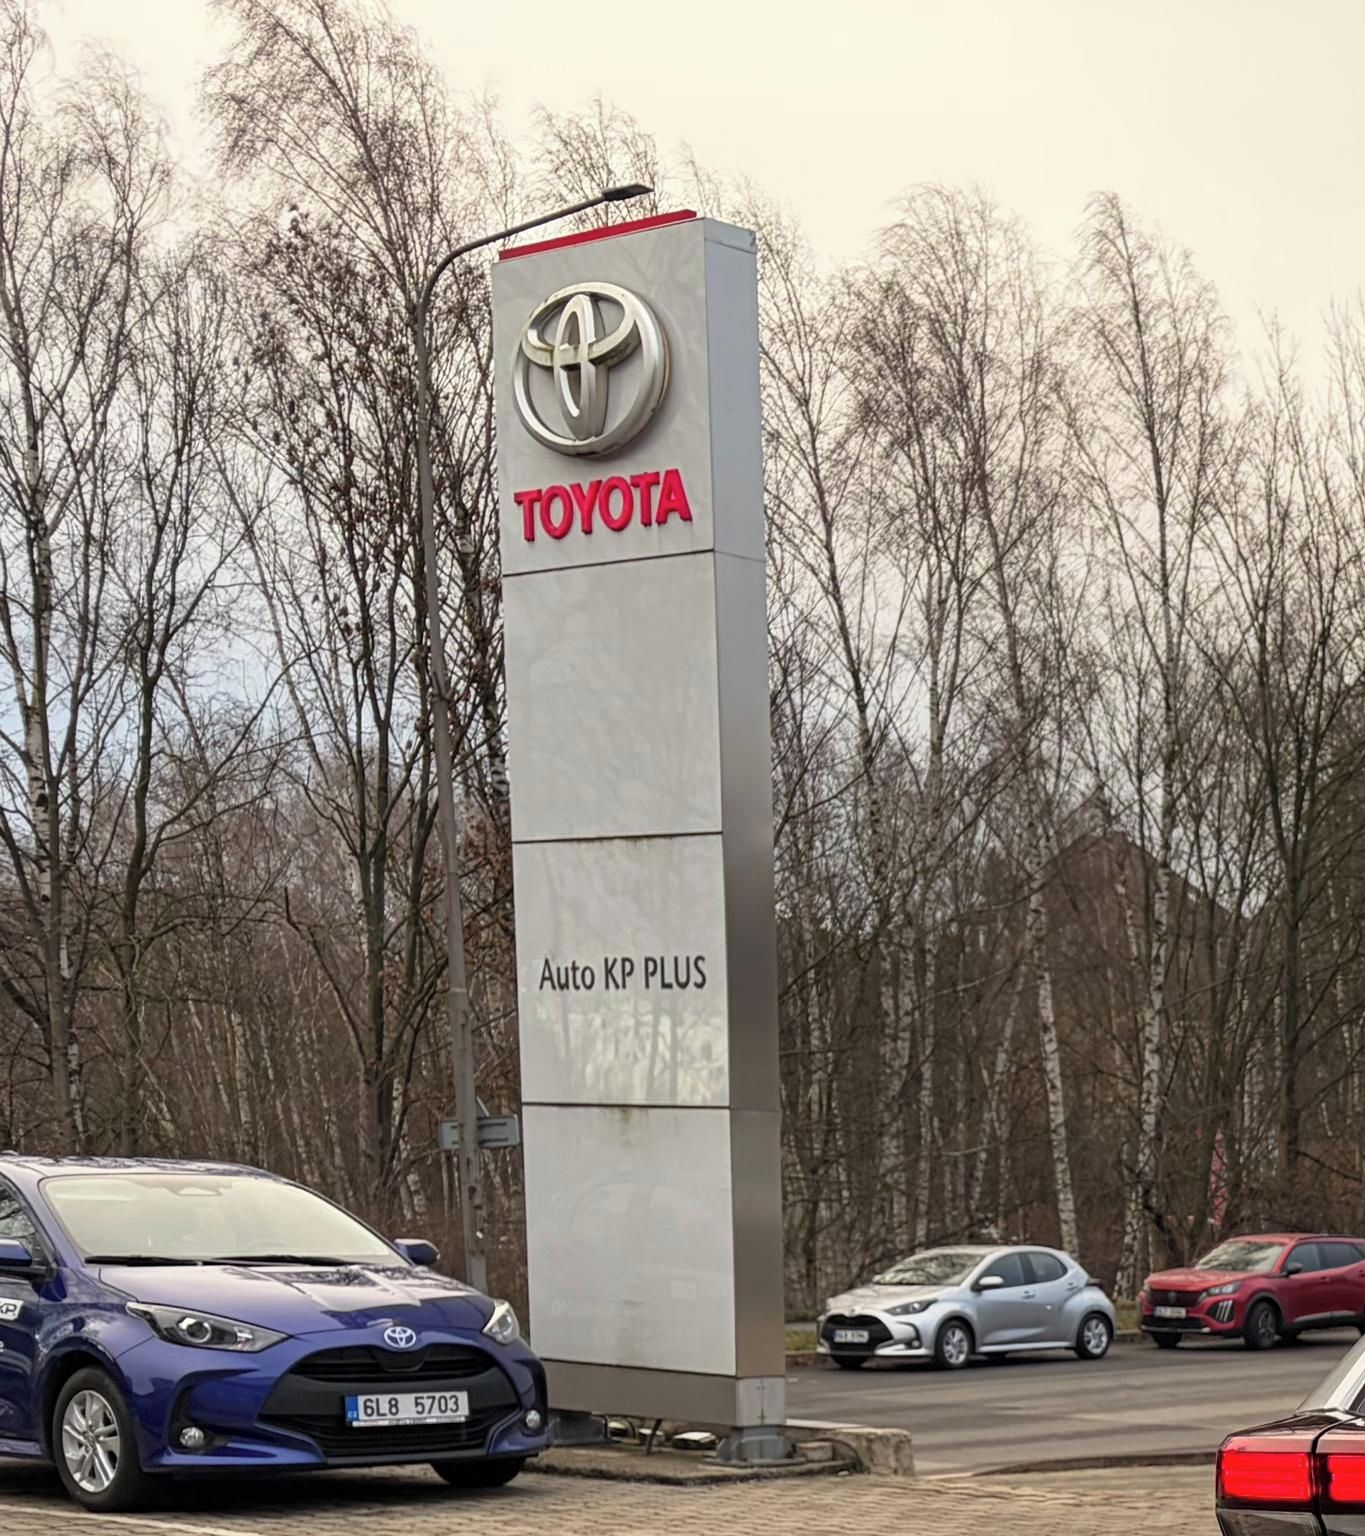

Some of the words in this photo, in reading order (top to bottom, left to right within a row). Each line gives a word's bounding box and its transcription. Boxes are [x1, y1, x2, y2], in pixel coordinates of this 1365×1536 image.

[514, 468, 693, 542] TOYOTA
[539, 958, 595, 991] Auto
[604, 957, 635, 990] KP
[644, 956, 707, 990] PLUS
[363, 1397, 400, 1417] 6L8
[414, 1394, 460, 1415] 5703
